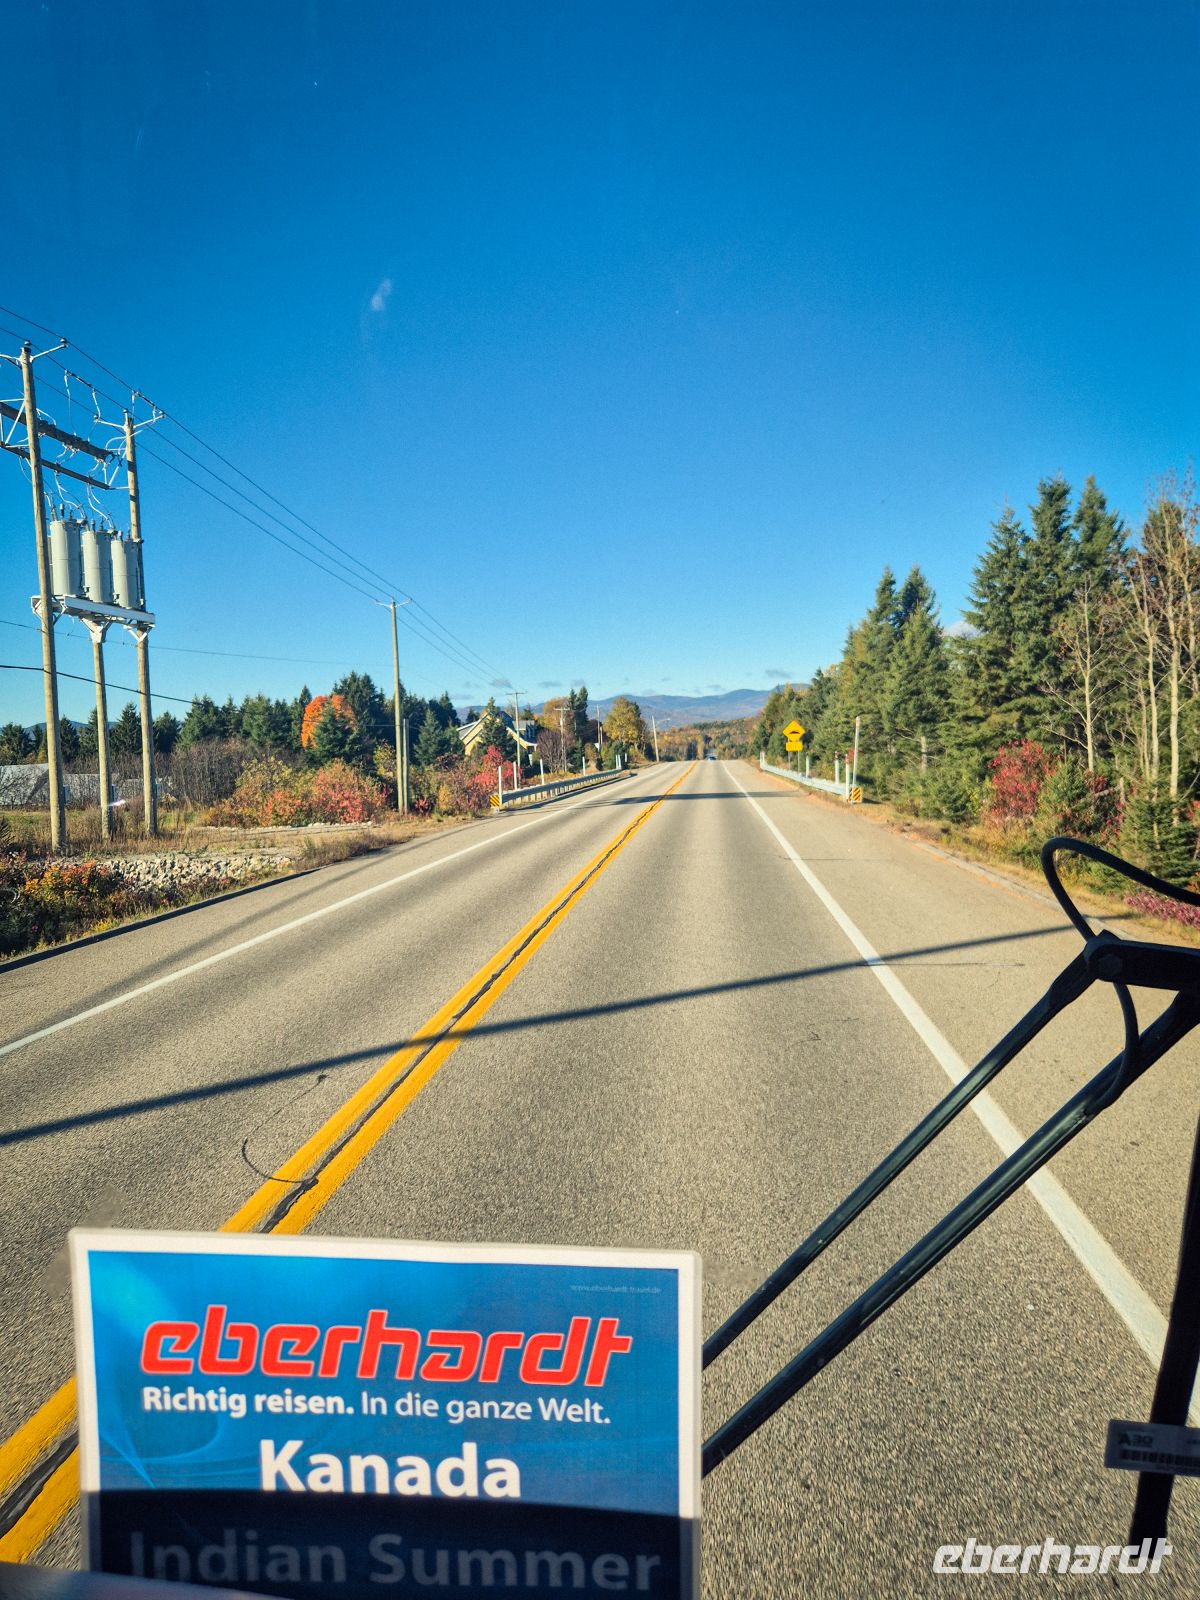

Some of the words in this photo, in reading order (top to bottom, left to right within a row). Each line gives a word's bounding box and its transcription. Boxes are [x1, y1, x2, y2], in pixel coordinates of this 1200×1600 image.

[141, 1305, 633, 1387] eberhardt
[143, 1386, 247, 1418] Richtig
[254, 1388, 354, 1415] reisen.
[361, 1391, 387, 1415] In
[395, 1391, 439, 1417] die
[446, 1399, 532, 1424] ganze
[538, 1397, 611, 1424] Welt.
[260, 1440, 521, 1498] Kanada
[130, 1529, 347, 1583] Indian
[369, 1533, 661, 1591] Summer
